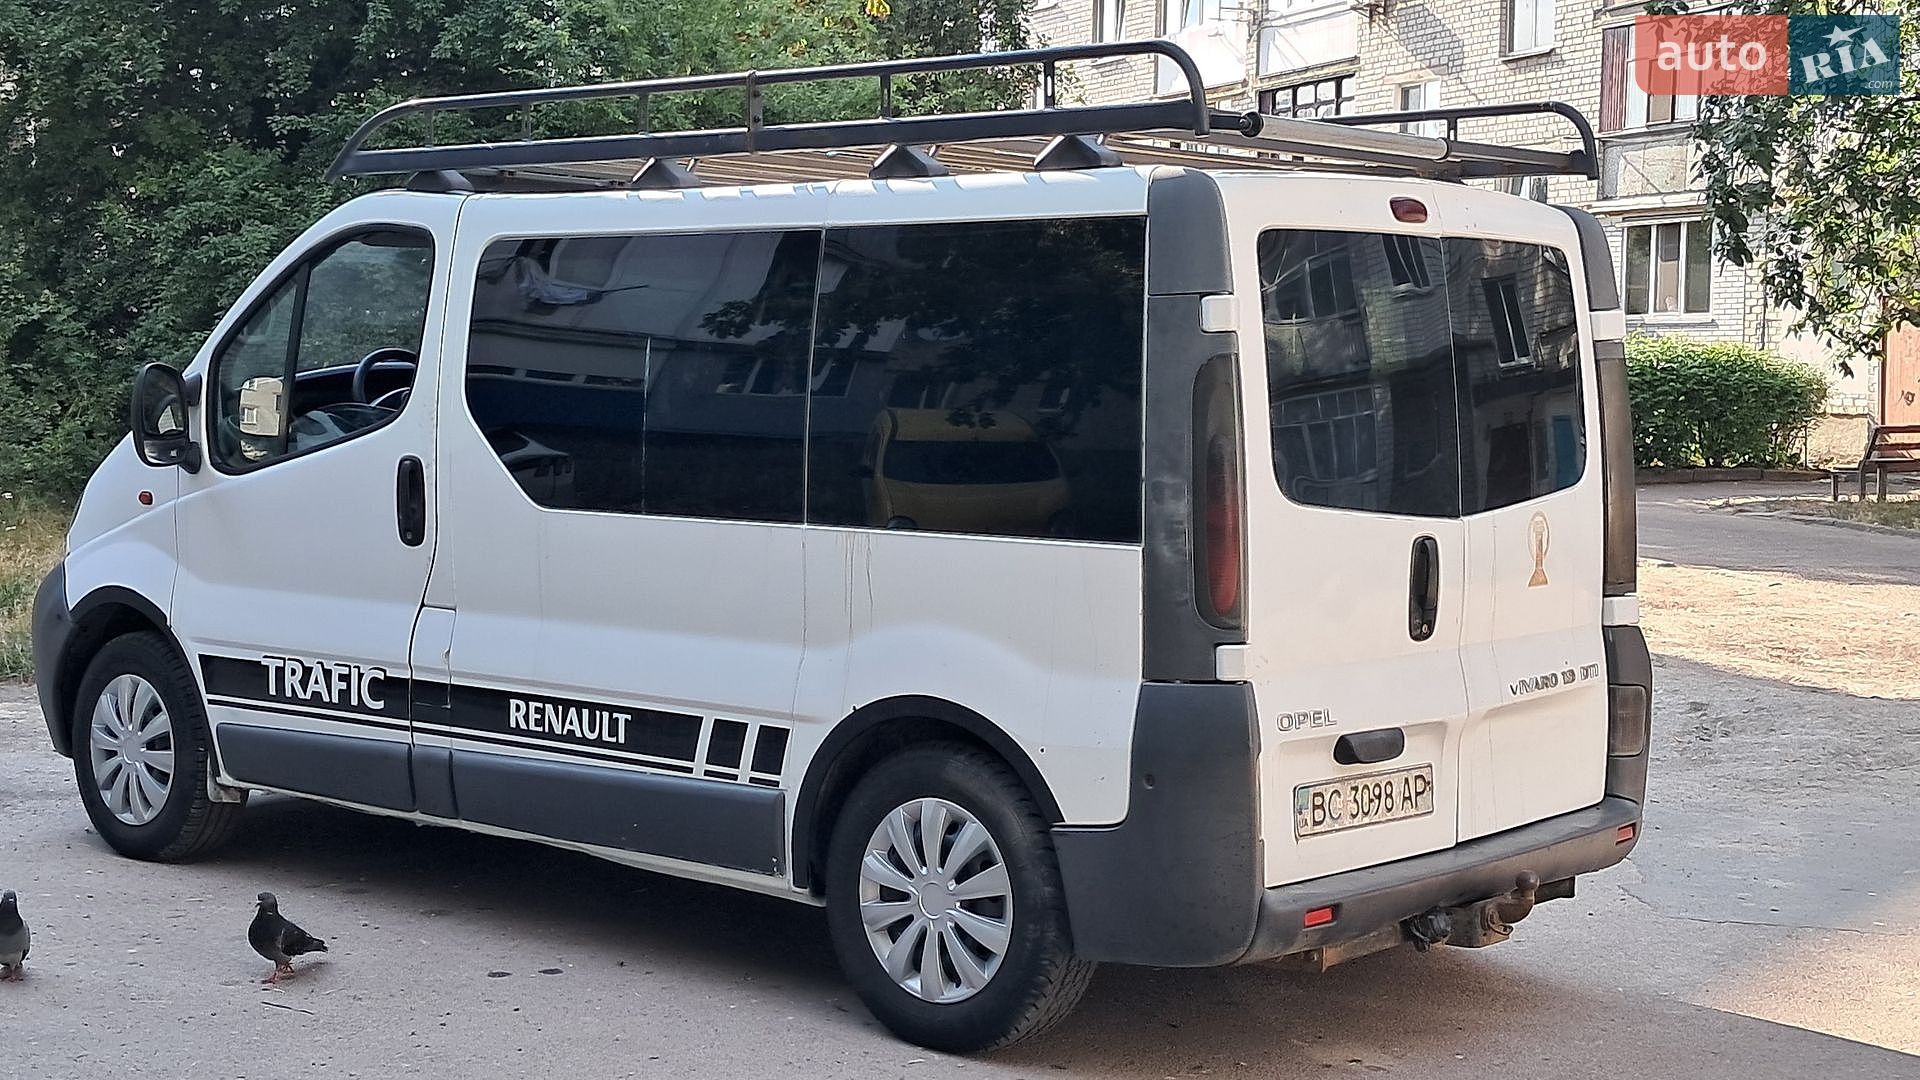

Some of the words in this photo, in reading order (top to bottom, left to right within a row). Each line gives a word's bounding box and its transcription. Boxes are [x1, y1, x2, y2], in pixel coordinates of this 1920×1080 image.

[261, 655, 387, 710] TRAFIC
[508, 699, 632, 744] RENAULT
[1276, 708, 1338, 733] OPEL
[1312, 789, 1341, 827] BC
[1350, 780, 1394, 819] 3098
[1401, 774, 1427, 812] AP
